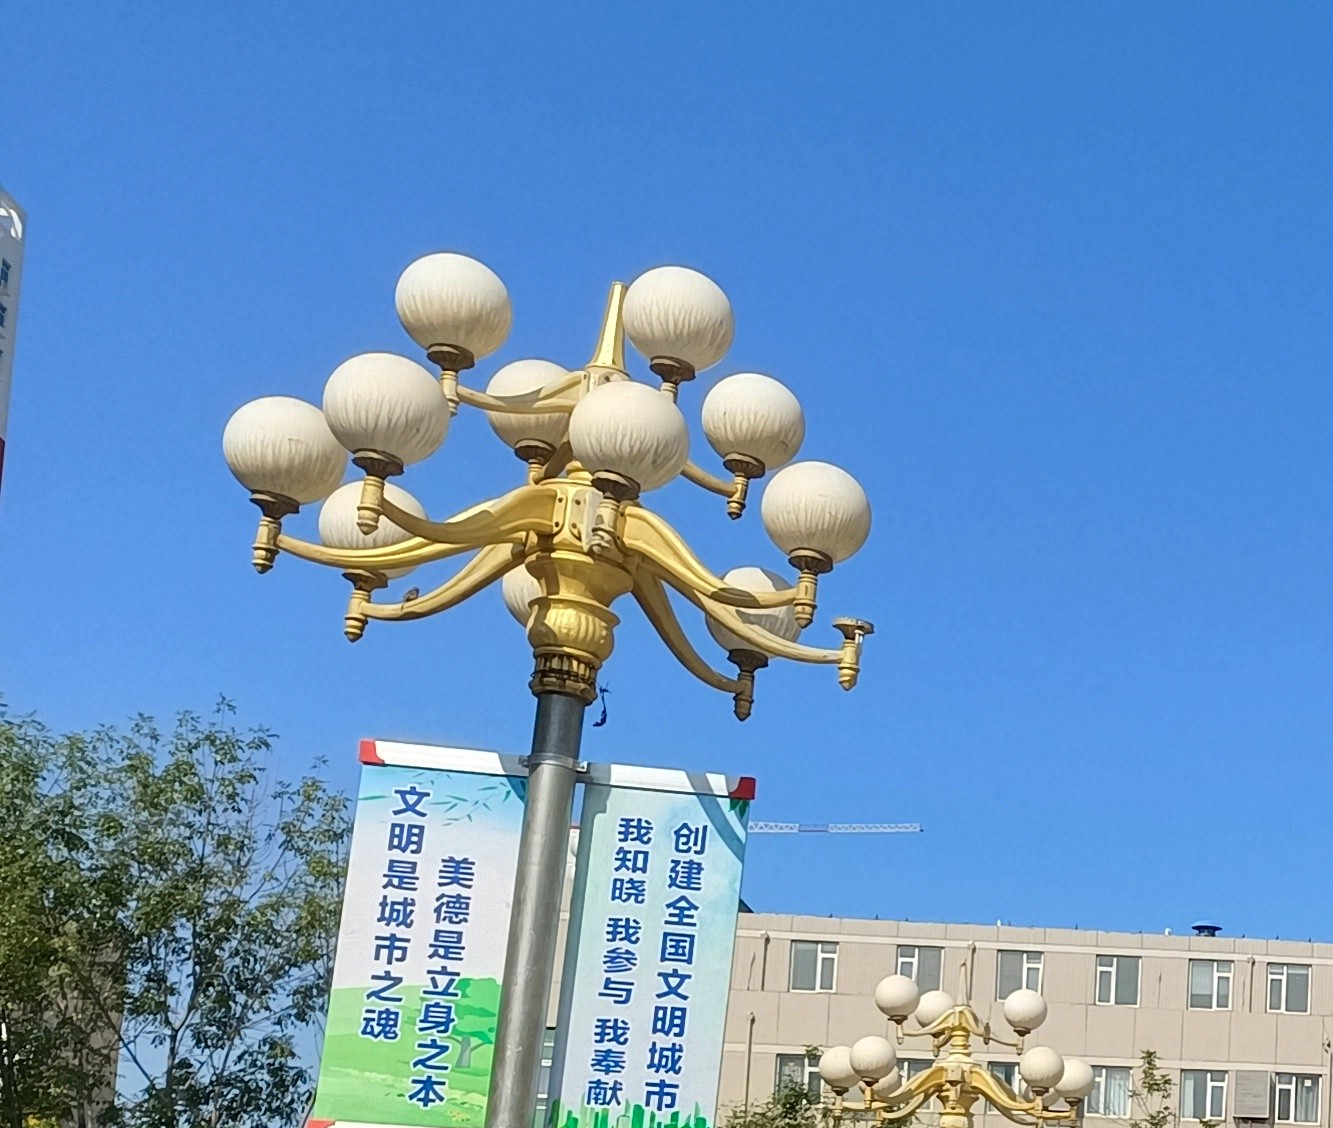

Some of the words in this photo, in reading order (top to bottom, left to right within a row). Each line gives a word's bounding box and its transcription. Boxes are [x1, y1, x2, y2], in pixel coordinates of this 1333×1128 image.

[360, 785, 431, 1042] 文明是城市之魂
[610, 817, 654, 905] 我知晓
[407, 856, 477, 1108] 美德是立身之本
[598, 917, 641, 1005] 我参与
[644, 823, 708, 1112] 创建全国文明城市
[587, 1018, 631, 1107] 我奉献
